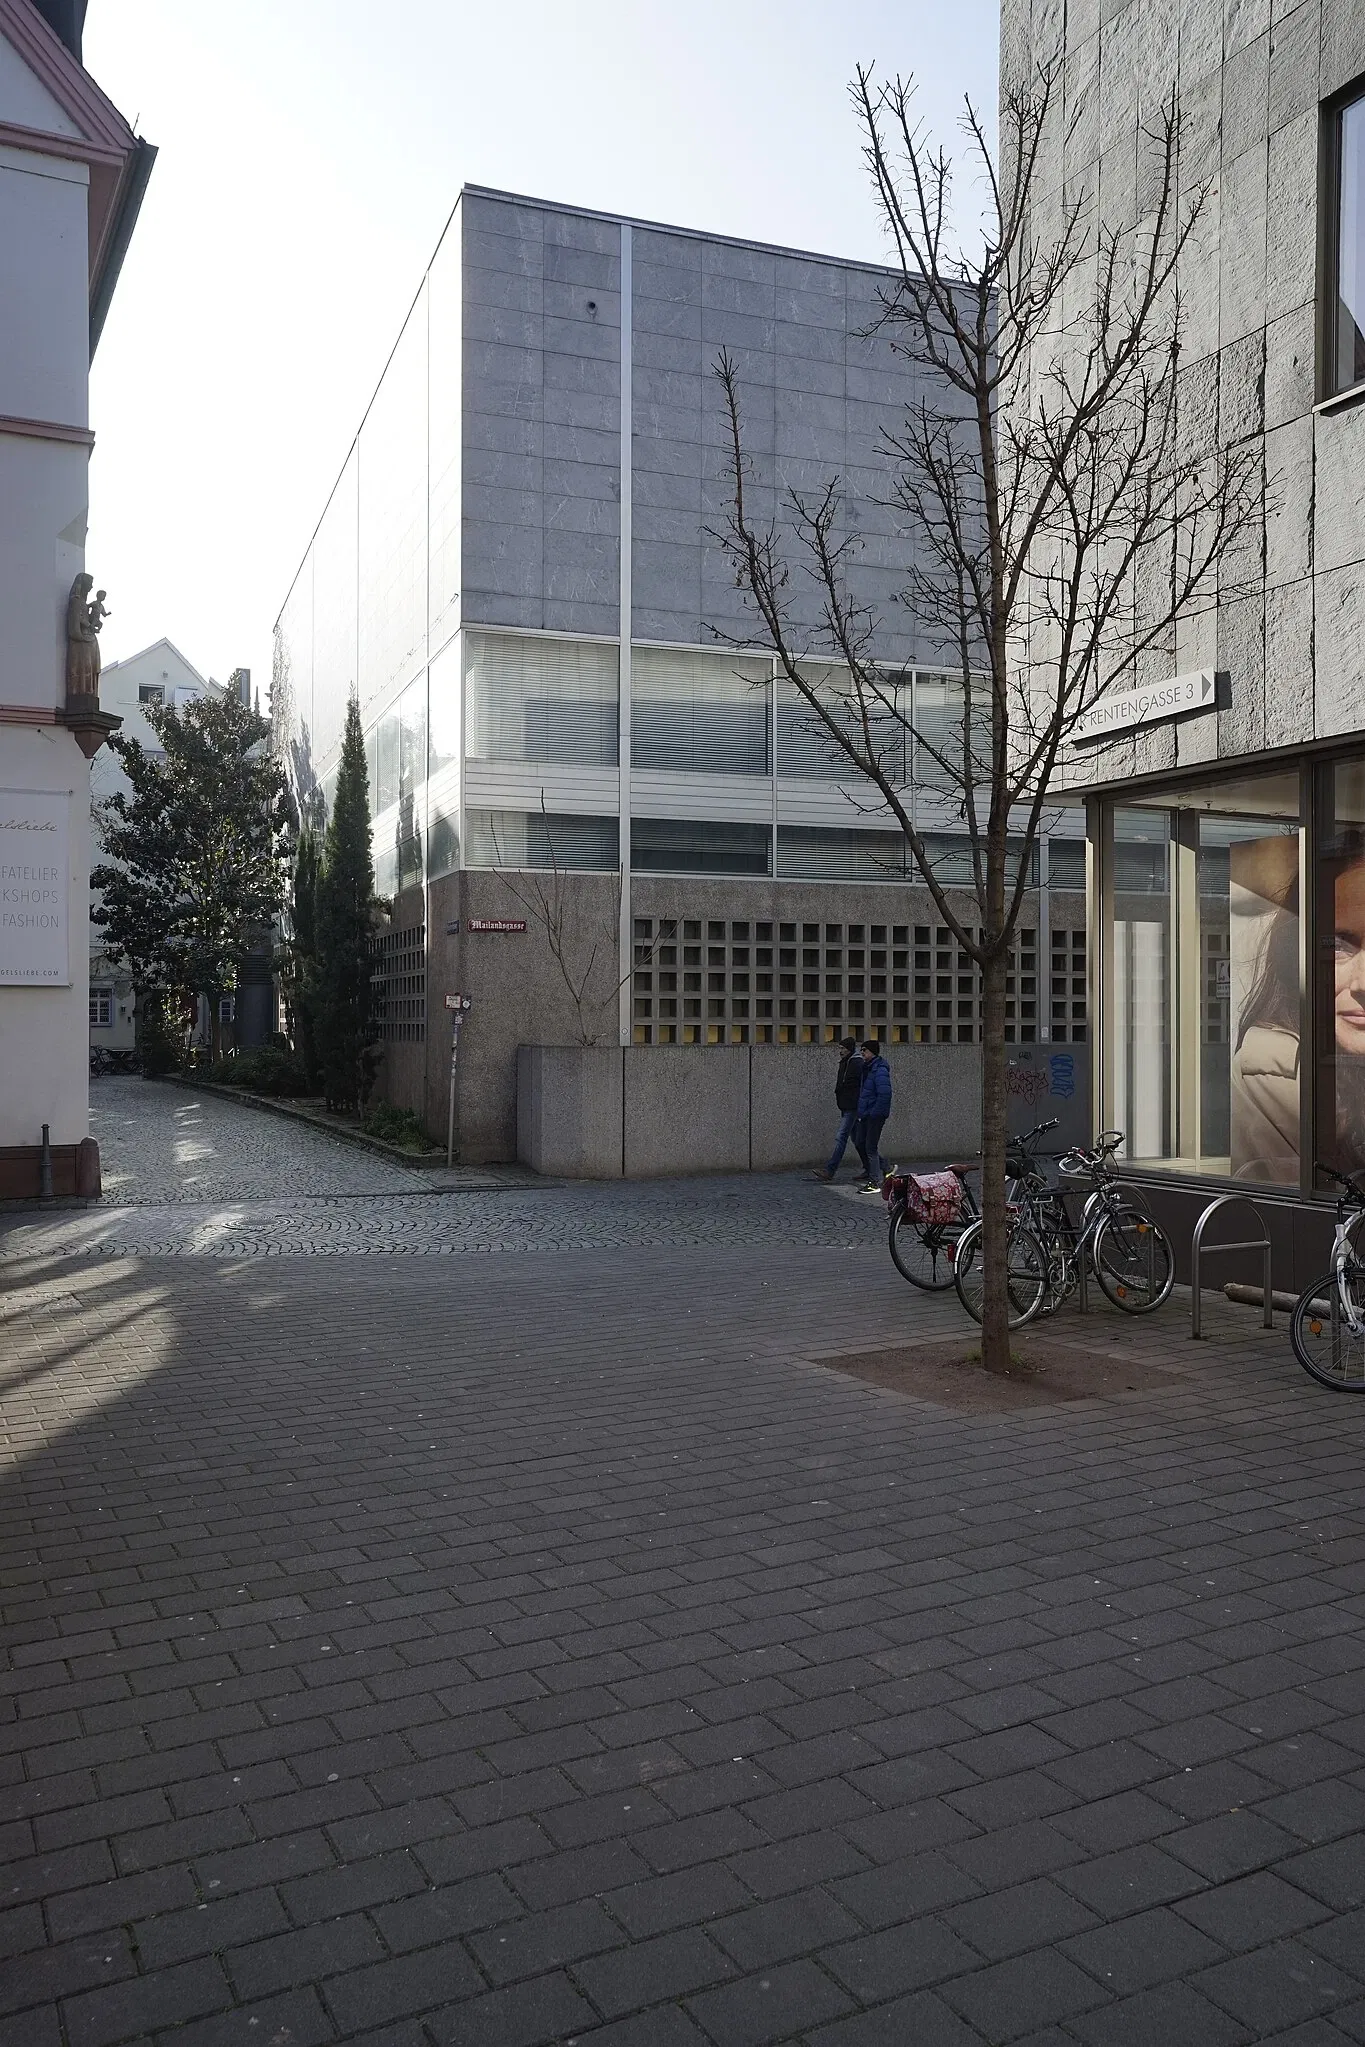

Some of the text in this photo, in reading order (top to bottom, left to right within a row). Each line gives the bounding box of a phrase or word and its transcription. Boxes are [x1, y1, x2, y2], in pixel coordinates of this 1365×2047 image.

[1090, 686, 1181, 726] RENTENGASSE
[1185, 683, 1194, 700] 3
[0, 888, 58, 904] KSHOPS
[2, 913, 59, 929] FASHION
[471, 920, 525, 931] Mailandsgasse
